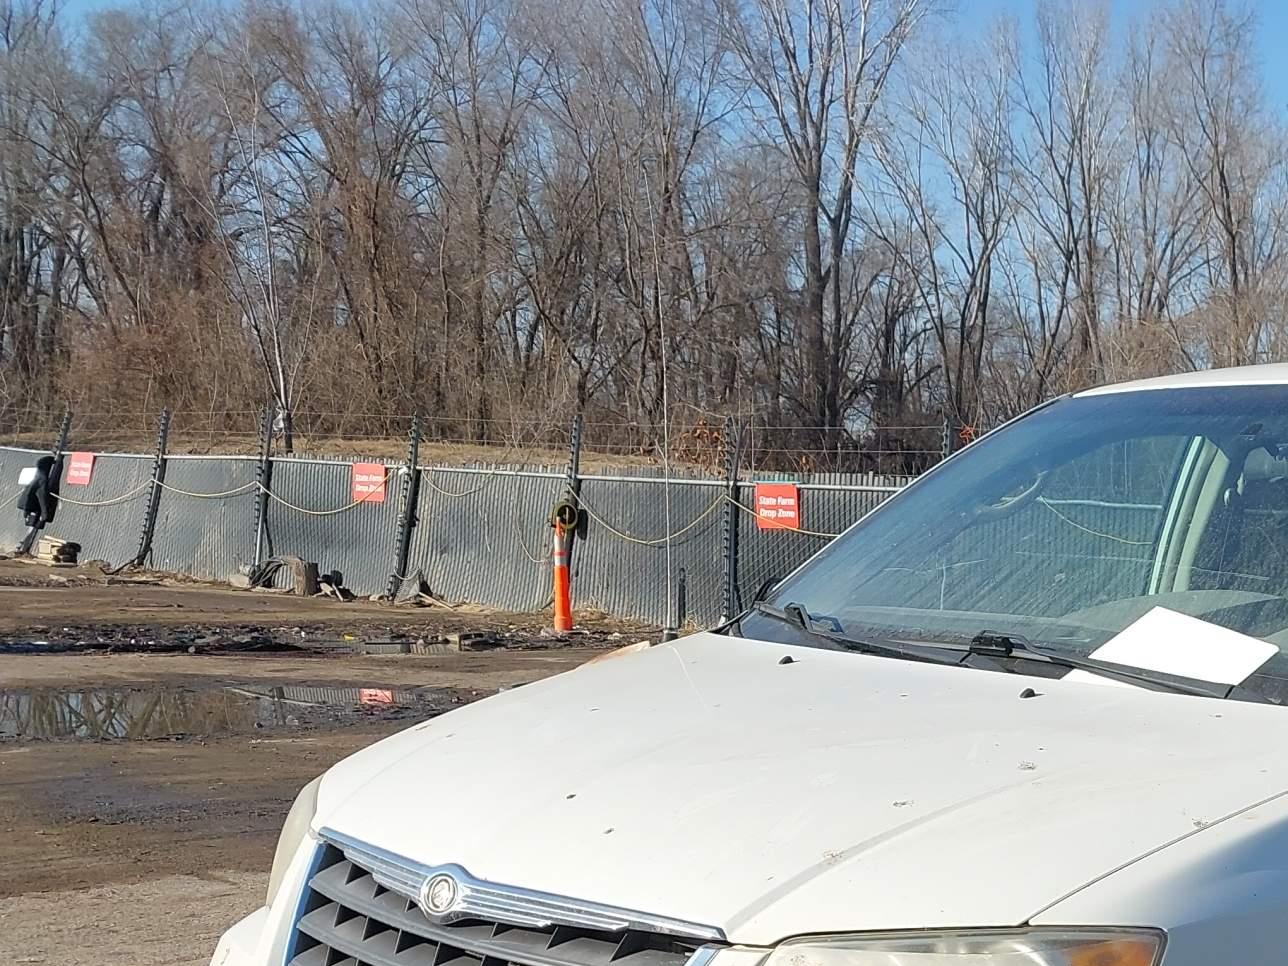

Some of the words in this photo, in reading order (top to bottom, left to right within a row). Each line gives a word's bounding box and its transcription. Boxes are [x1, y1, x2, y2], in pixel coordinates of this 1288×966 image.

[758, 495, 777, 506] State
[759, 507, 777, 520] Drop
[777, 508, 796, 519] Zone
